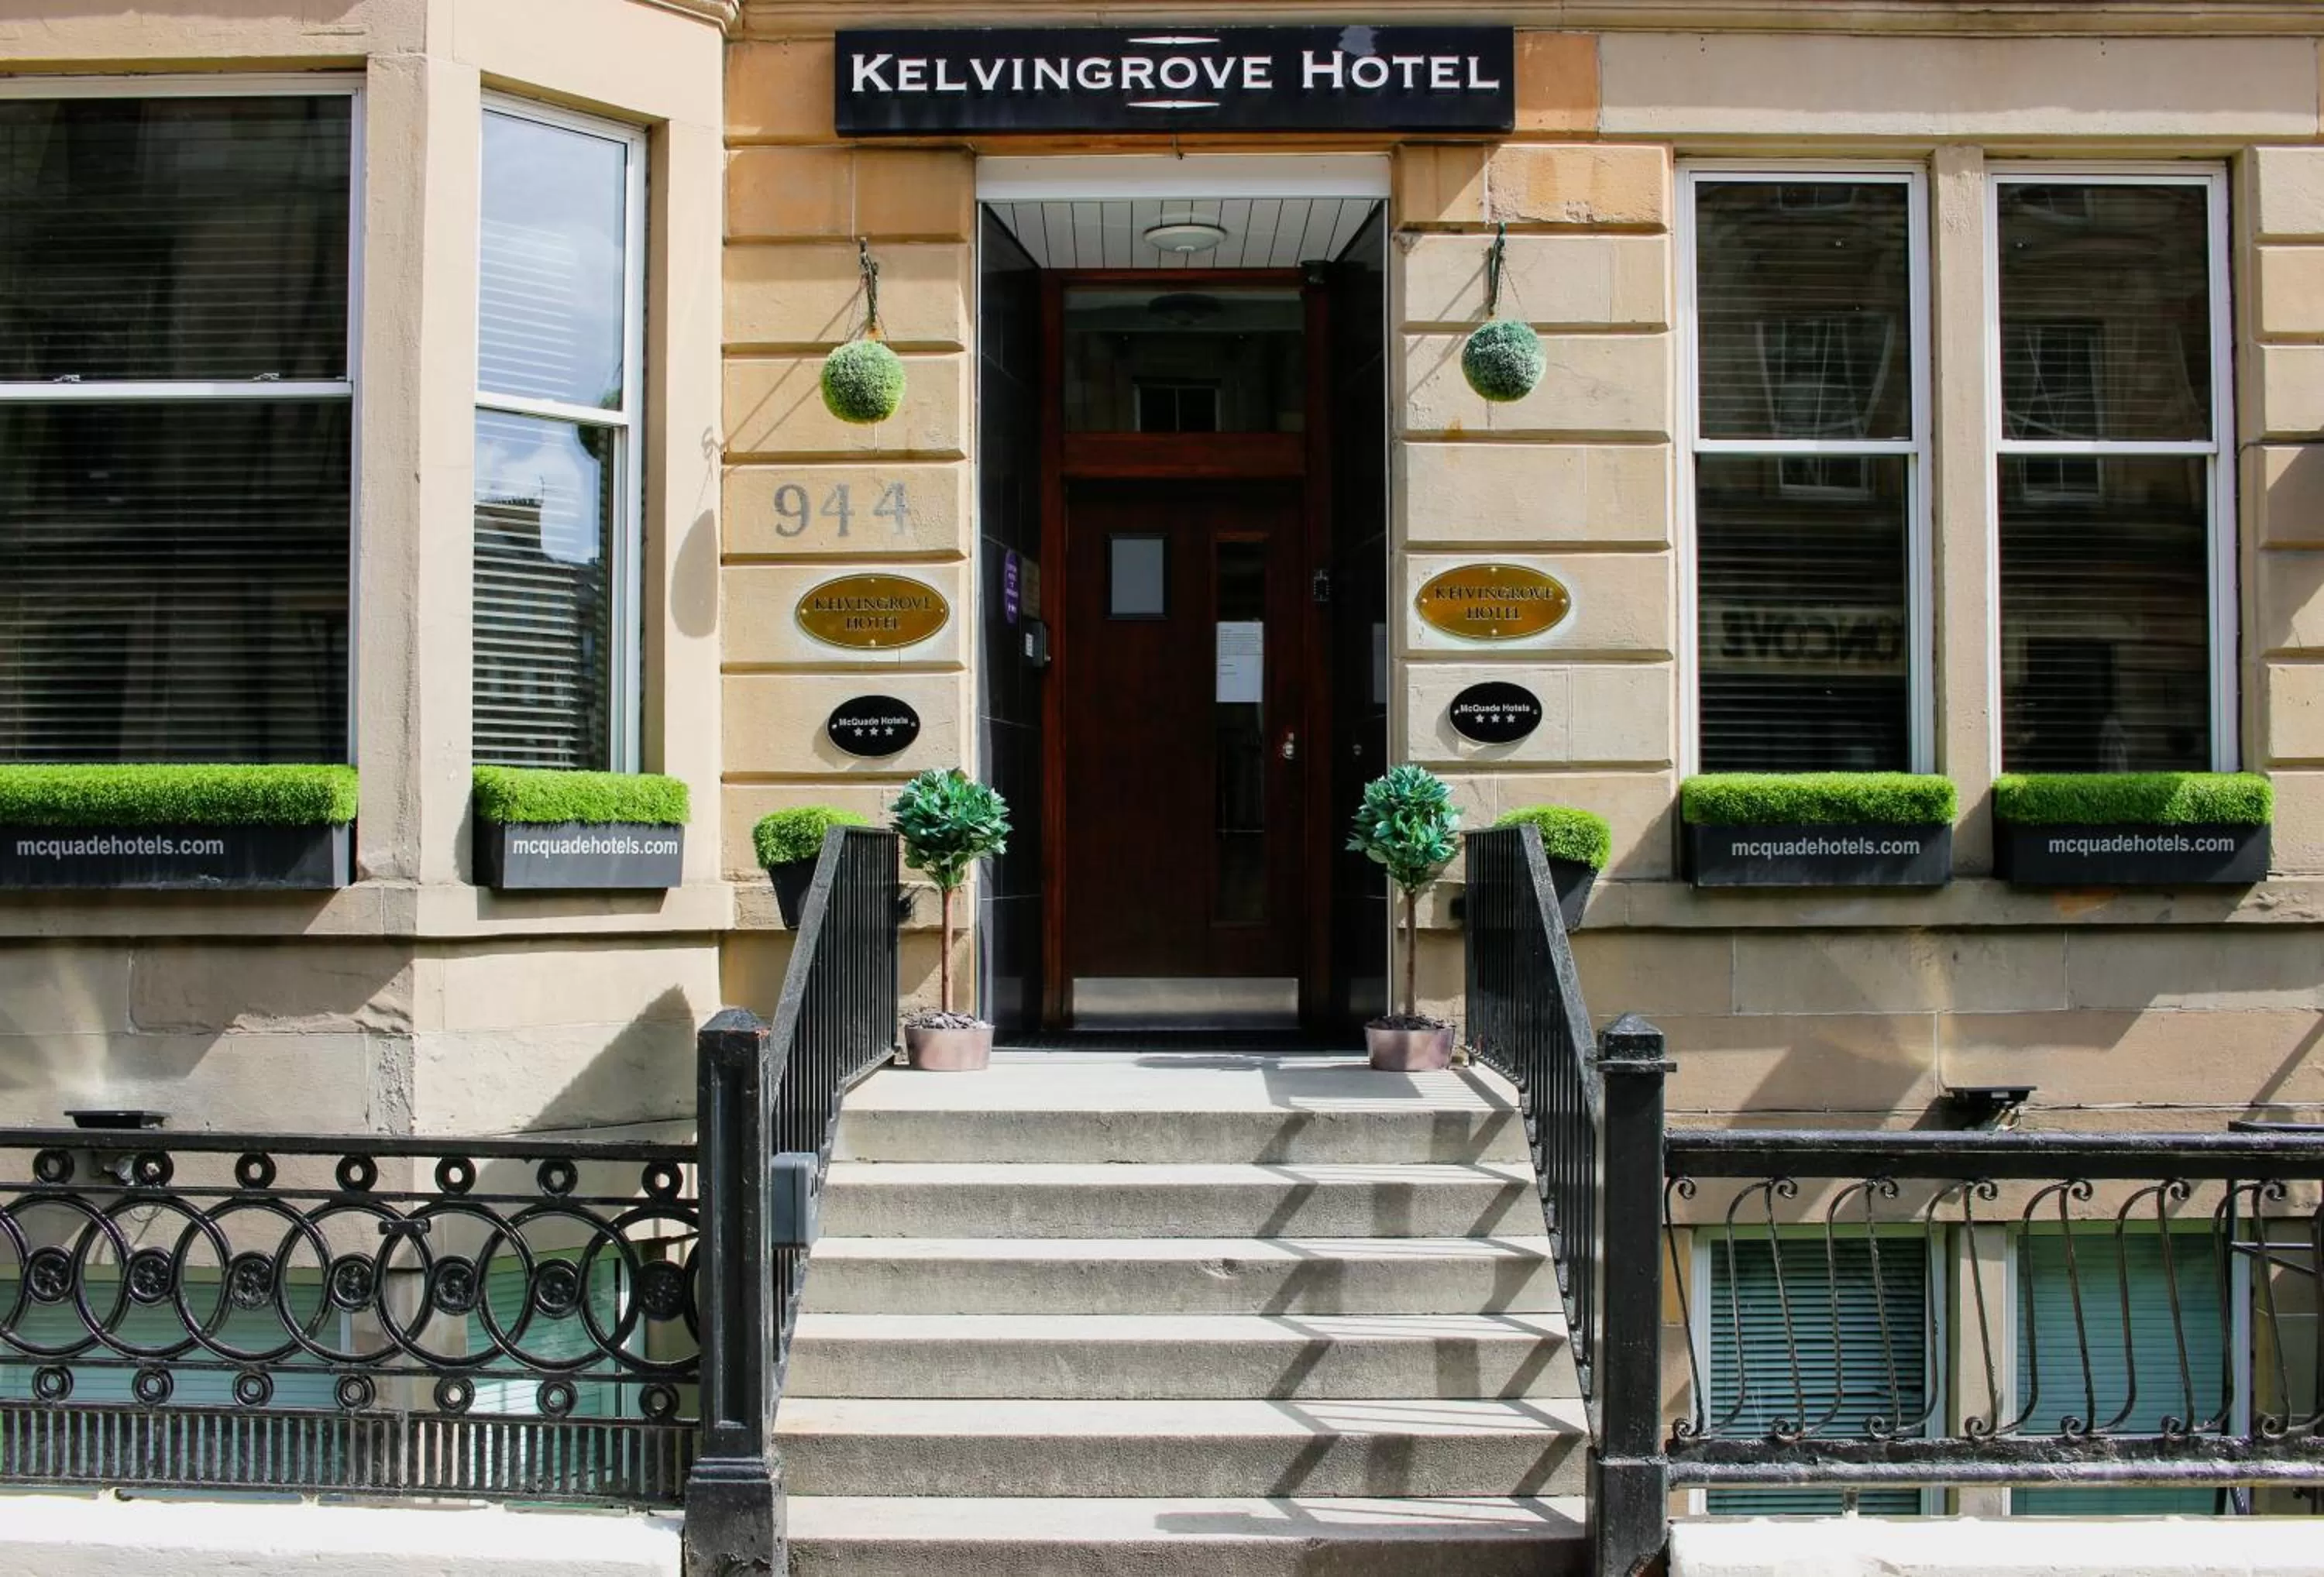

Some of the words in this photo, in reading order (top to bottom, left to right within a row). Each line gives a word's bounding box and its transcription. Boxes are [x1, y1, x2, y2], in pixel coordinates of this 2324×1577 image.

[851, 51, 1273, 92] KELVINGROVE
[1302, 50, 1501, 91] HOTEL
[774, 483, 912, 538] 944
[1435, 586, 1553, 601] KELVINGROVE
[814, 596, 932, 611] KELVINGROVE
[1466, 606, 1522, 620] HOTEL
[846, 616, 902, 631] HOTEL
[1459, 703, 1501, 713] McQuade
[1502, 703, 1531, 713] Hotels
[838, 716, 879, 727] McQuade
[881, 716, 909, 726] Hotels
[16, 834, 225, 860] mcquadehotels.com
[513, 835, 679, 859] mcquadehotels.com
[1731, 837, 1920, 860] mcquadehotels.com
[2048, 834, 2235, 857] mcquadehotels.com
